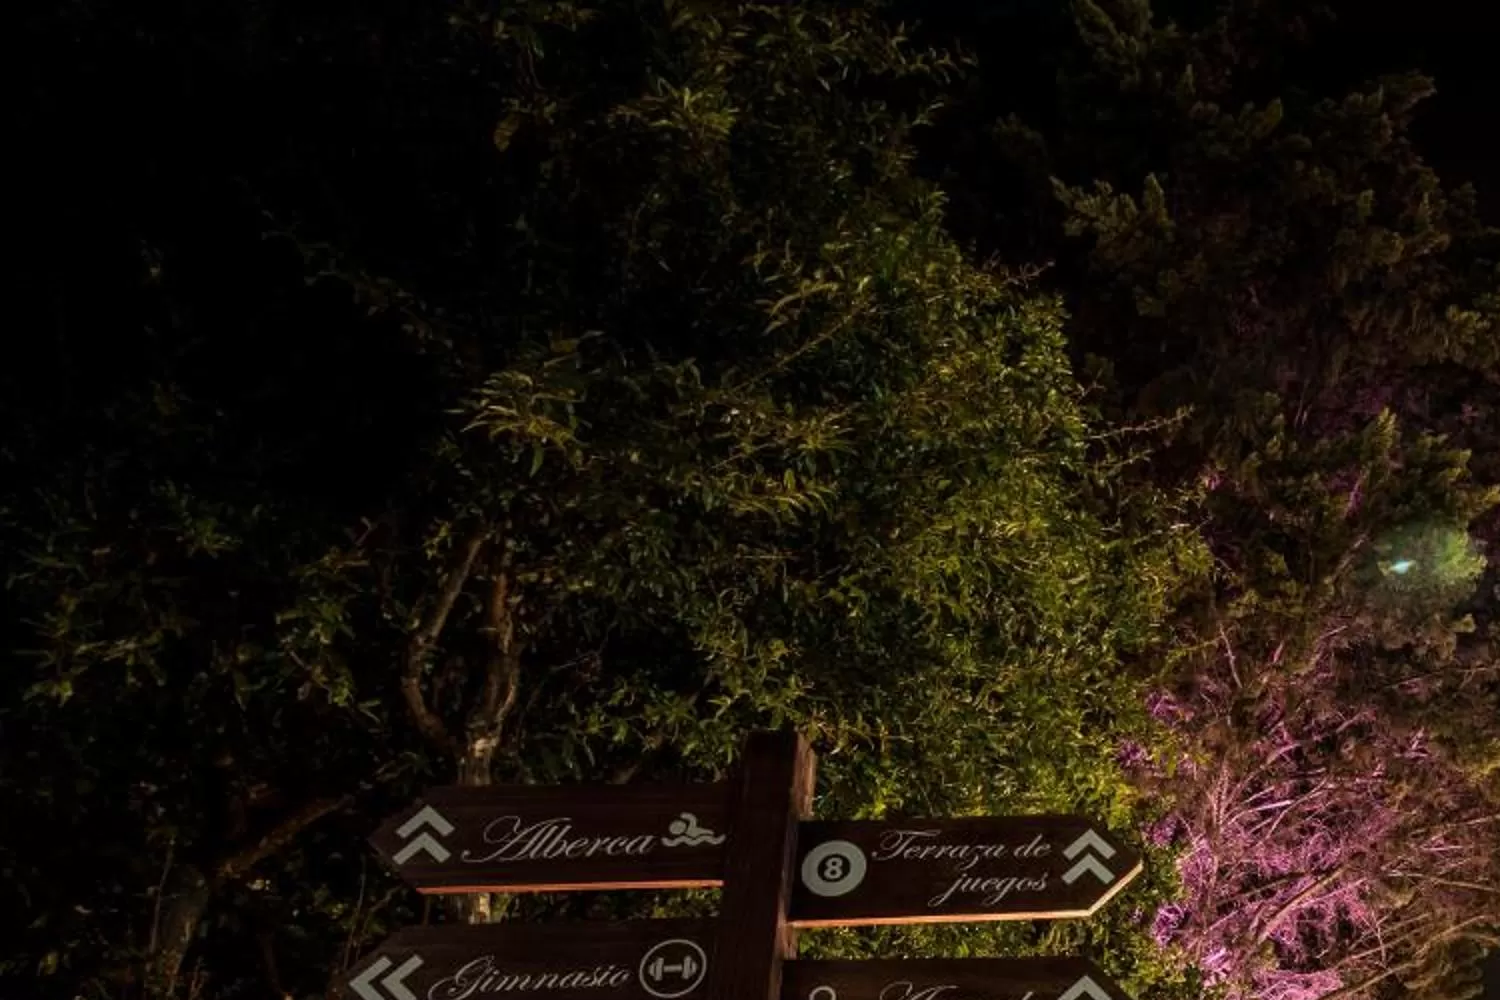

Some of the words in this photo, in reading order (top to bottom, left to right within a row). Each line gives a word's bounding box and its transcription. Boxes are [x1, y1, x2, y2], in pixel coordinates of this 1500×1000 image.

[460, 814, 657, 864] Alberca
[871, 828, 1007, 870] Terraza
[1013, 833, 1053, 859] de
[824, 857, 841, 880] 8
[927, 872, 1050, 907] juegos
